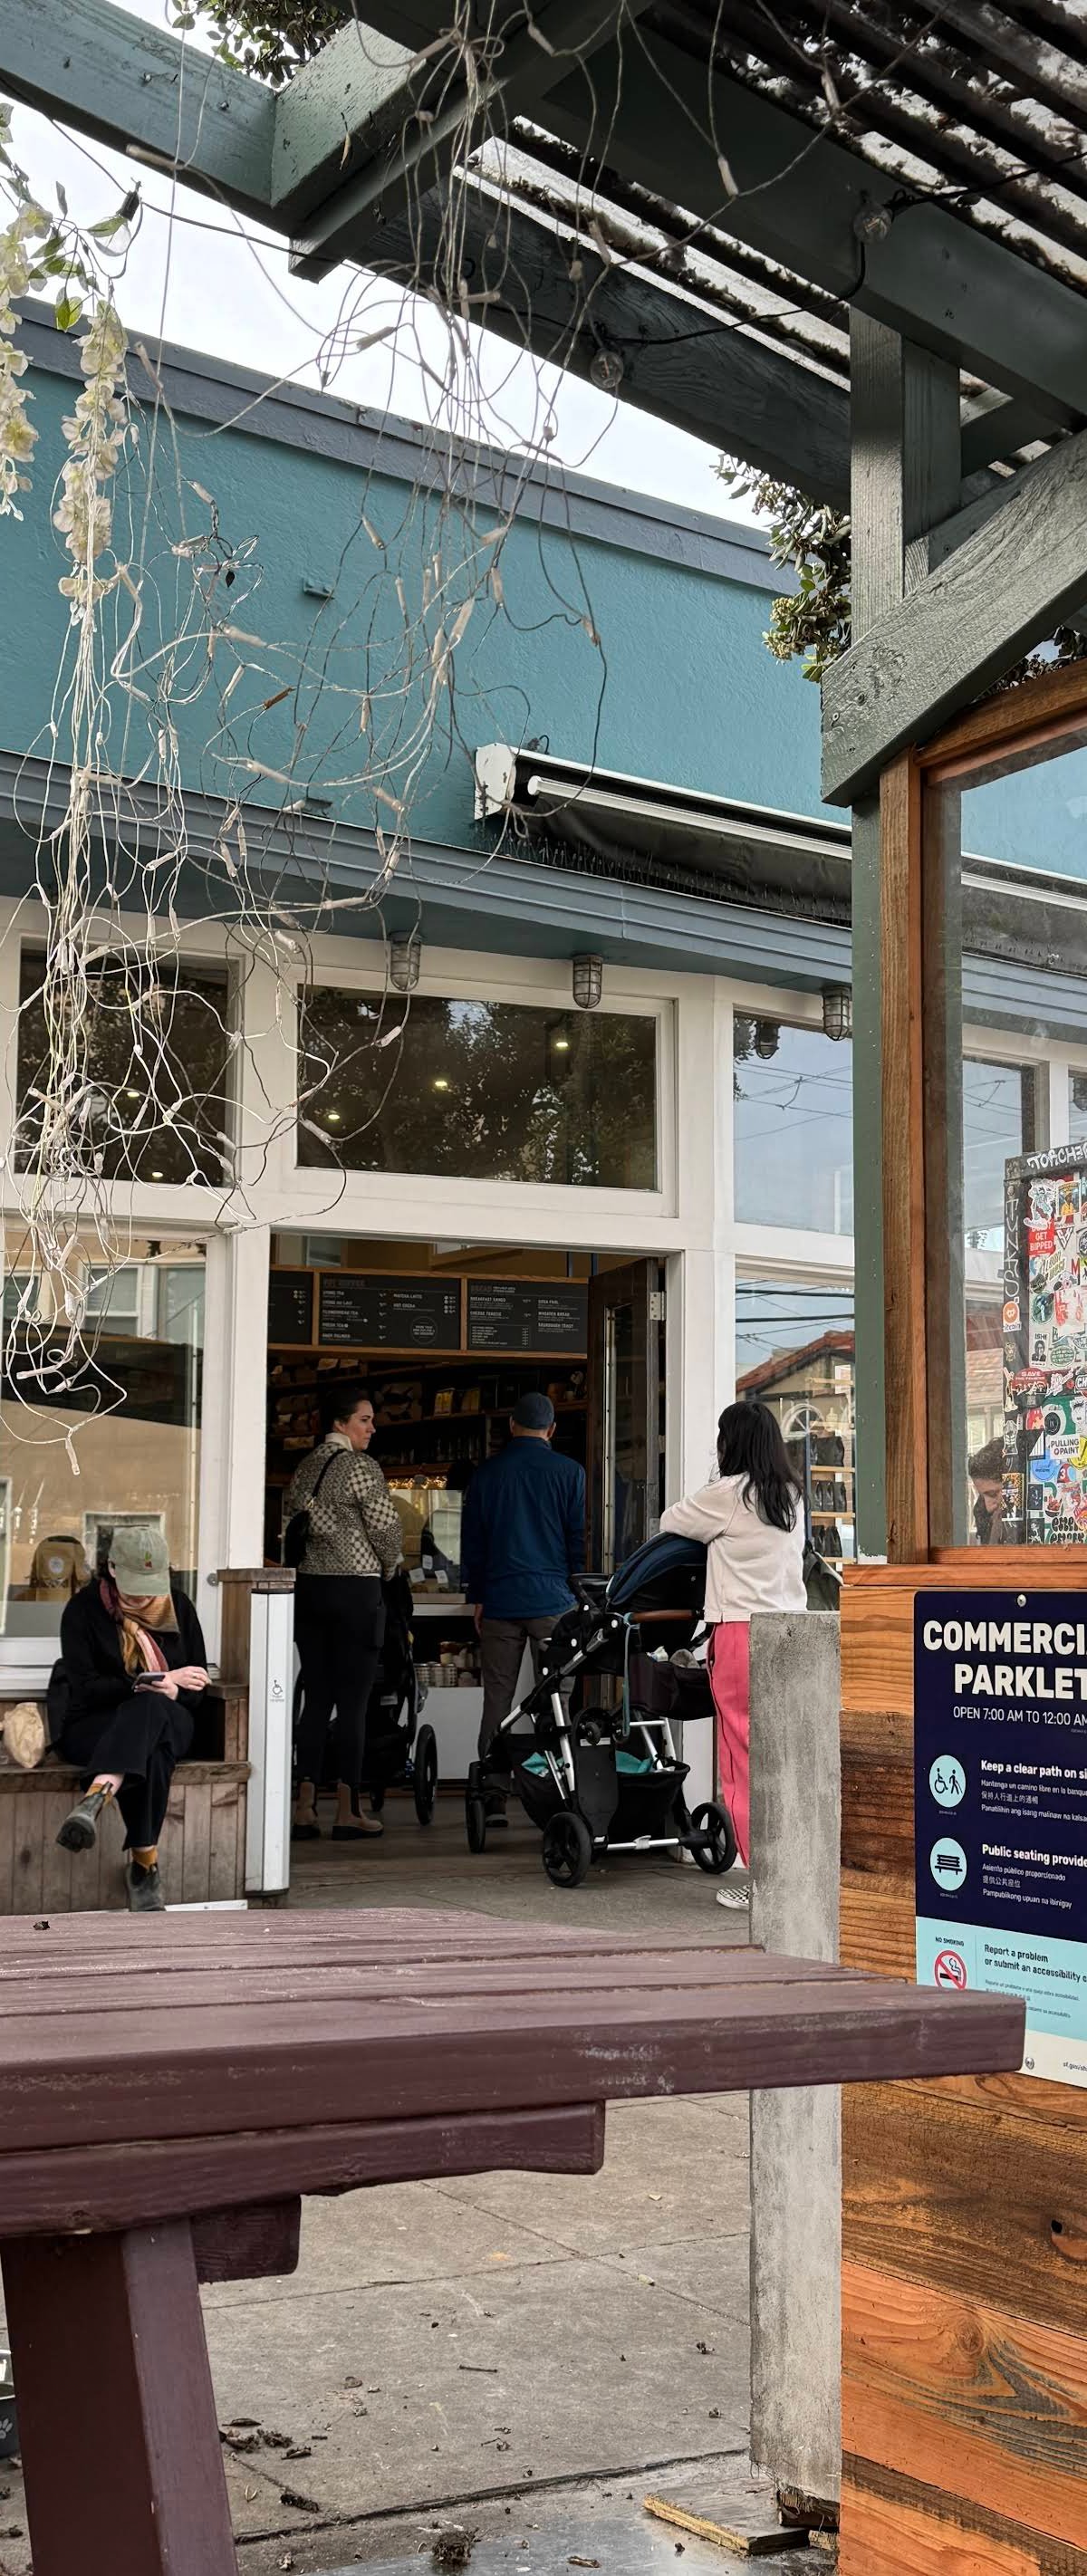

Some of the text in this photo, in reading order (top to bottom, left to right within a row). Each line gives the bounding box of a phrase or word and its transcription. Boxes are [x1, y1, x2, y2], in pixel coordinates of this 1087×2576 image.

[1034, 1232, 1047, 1241] GET
[1051, 1438, 1080, 1447] PULLING
[1060, 1469, 1065, 1480] 3
[923, 1620, 1087, 1656] COMMERCI
[954, 1663, 1087, 1701] PARKLET
[953, 1706, 980, 1719] OPEN
[983, 1707, 1004, 1721] 7:00
[1007, 1710, 1024, 1722] AM
[1025, 1710, 1040, 1723] TO
[1043, 1712, 1071, 1725] 12:00
[981, 1760, 1004, 1774] Keep
[1005, 1764, 1012, 1773] a
[1013, 1763, 1036, 1775] clear
[1040, 1764, 1062, 1778] path
[1063, 1769, 1076, 1779] on
[981, 1779, 1008, 1790] Mantenga
[1016, 1783, 1038, 1792] camino
[1039, 1784, 1051, 1793] libre
[1060, 1786, 1067, 1794] la
[1011, 1808, 1022, 1817] ang
[1022, 1808, 1038, 1819] isang
[982, 1844, 1012, 1858] Public
[1014, 1849, 1050, 1865] seating
[982, 1863, 1065, 1881] Asiento público proporcionado
[982, 1889, 1022, 1902] Pampublikong
[1022, 1895, 1040, 1904] upuan
[943, 1937, 965, 1946] SMOKING
[984, 1944, 1009, 1956] Report
[1017, 1950, 1048, 1963] problem
[995, 1959, 1020, 1971] submit
[1022, 1965, 1031, 1973] an
[1033, 1966, 1080, 1983] accessibility
